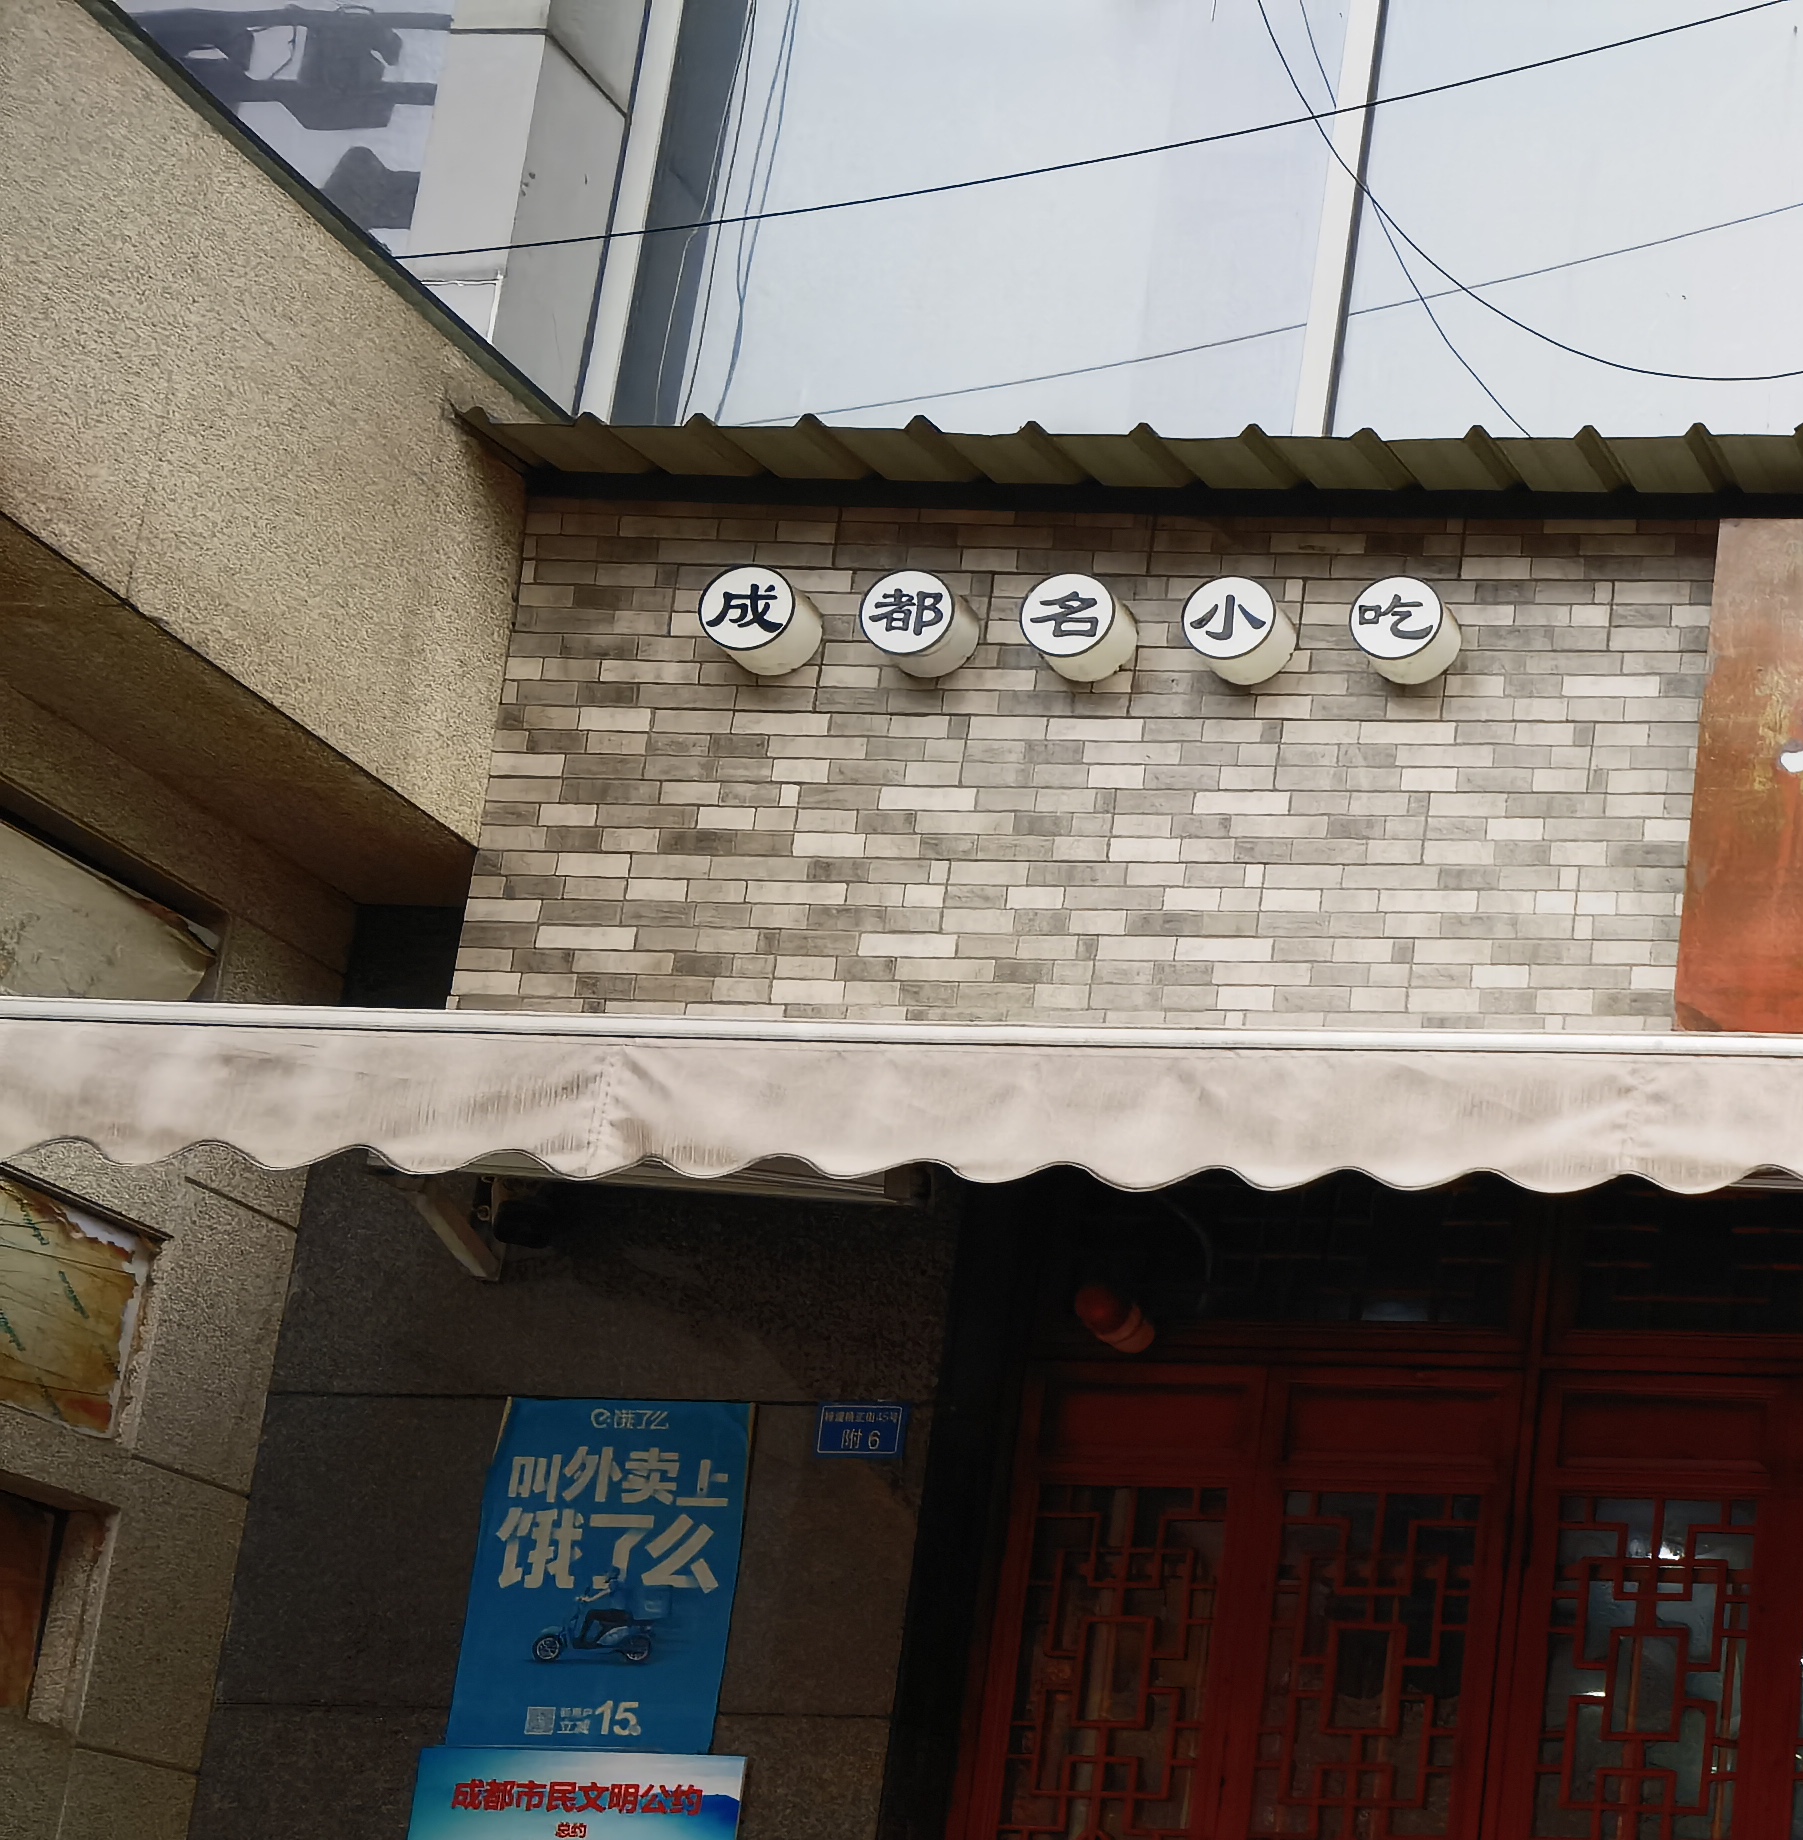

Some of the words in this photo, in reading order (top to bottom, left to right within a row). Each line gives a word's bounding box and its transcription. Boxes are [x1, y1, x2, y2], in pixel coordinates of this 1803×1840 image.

[705, 583, 1434, 641] 成都名小吃
[507, 1446, 730, 1508] 叫外卖上
[496, 1507, 719, 1594] 饿了么
[451, 1778, 704, 1817] 成都市民文明公约
